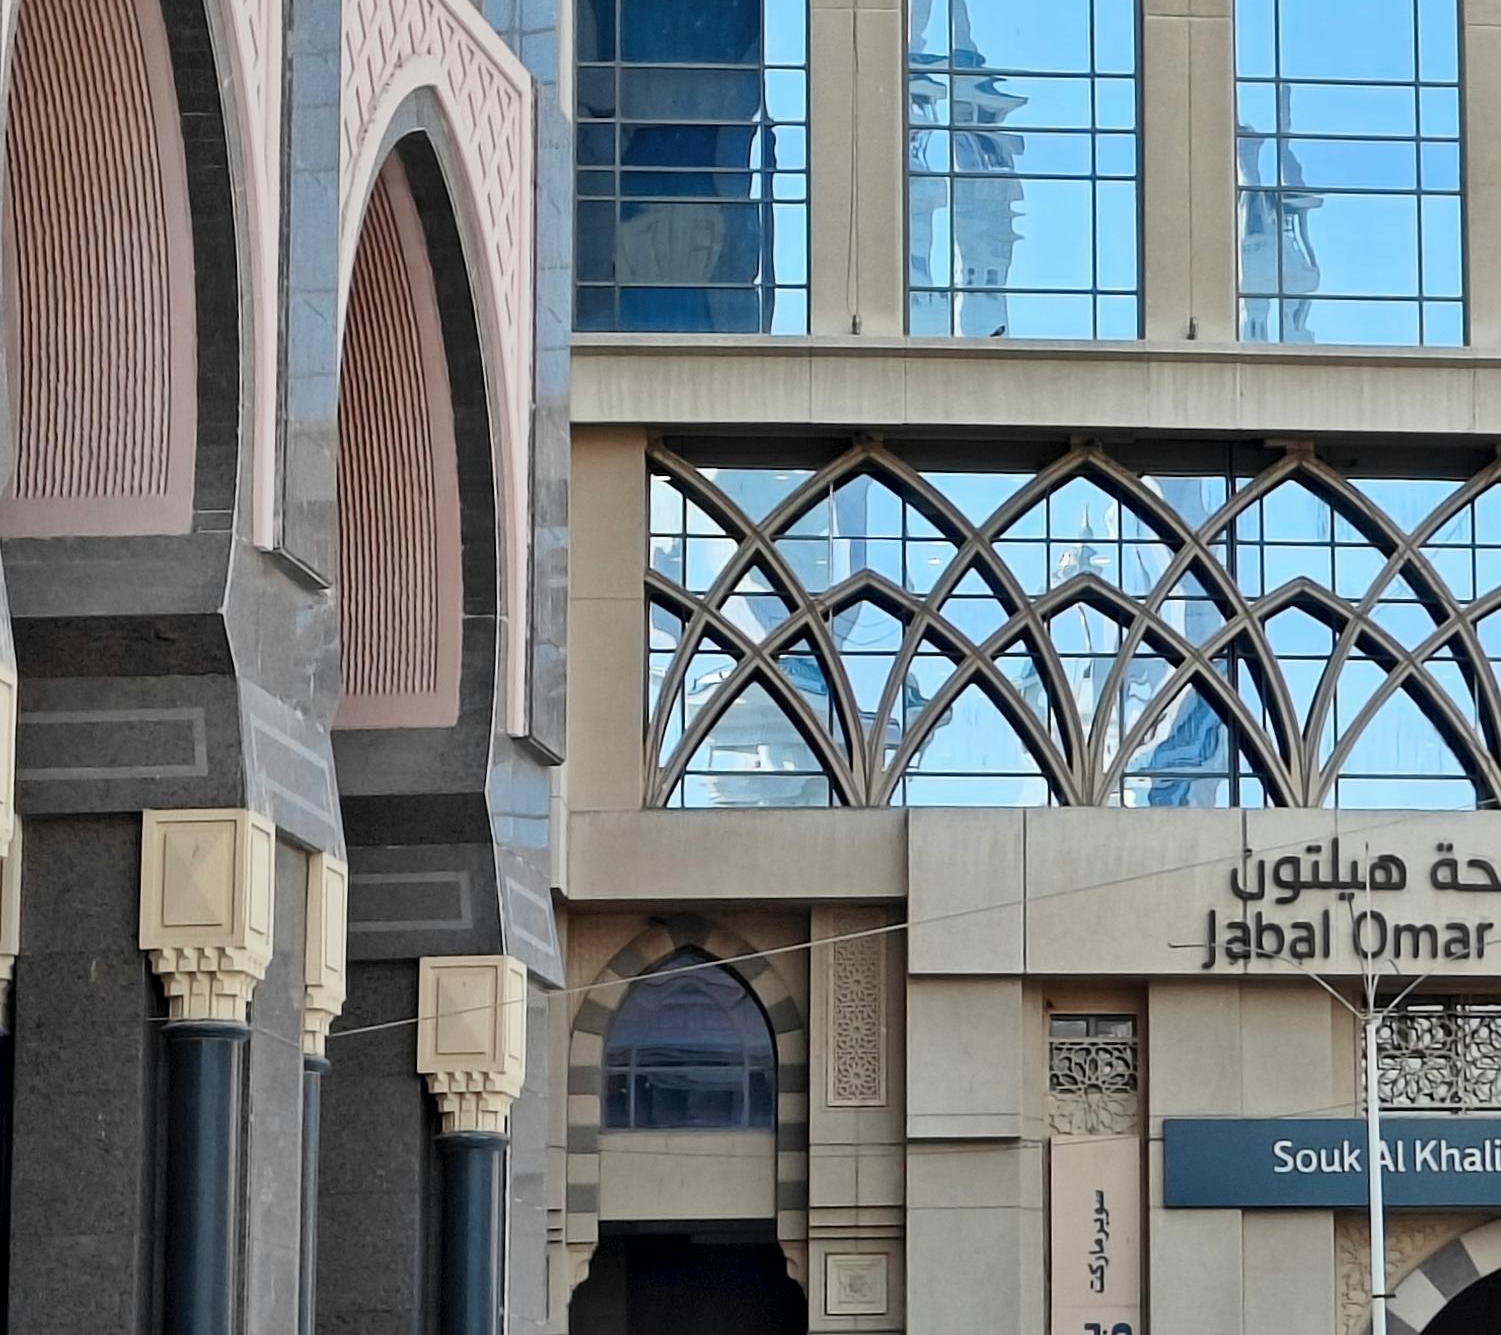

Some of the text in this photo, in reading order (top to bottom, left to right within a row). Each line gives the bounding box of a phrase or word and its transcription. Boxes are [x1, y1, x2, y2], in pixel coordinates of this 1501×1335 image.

[1231, 844, 1407, 903] هيلتون
[1202, 909, 1331, 969] Jabal
[1353, 910, 1493, 959] Omar
[1273, 1139, 1362, 1173] Souk
[1373, 1139, 1406, 1172] Al
[1088, 1189, 1111, 1294] سوبرماركت
